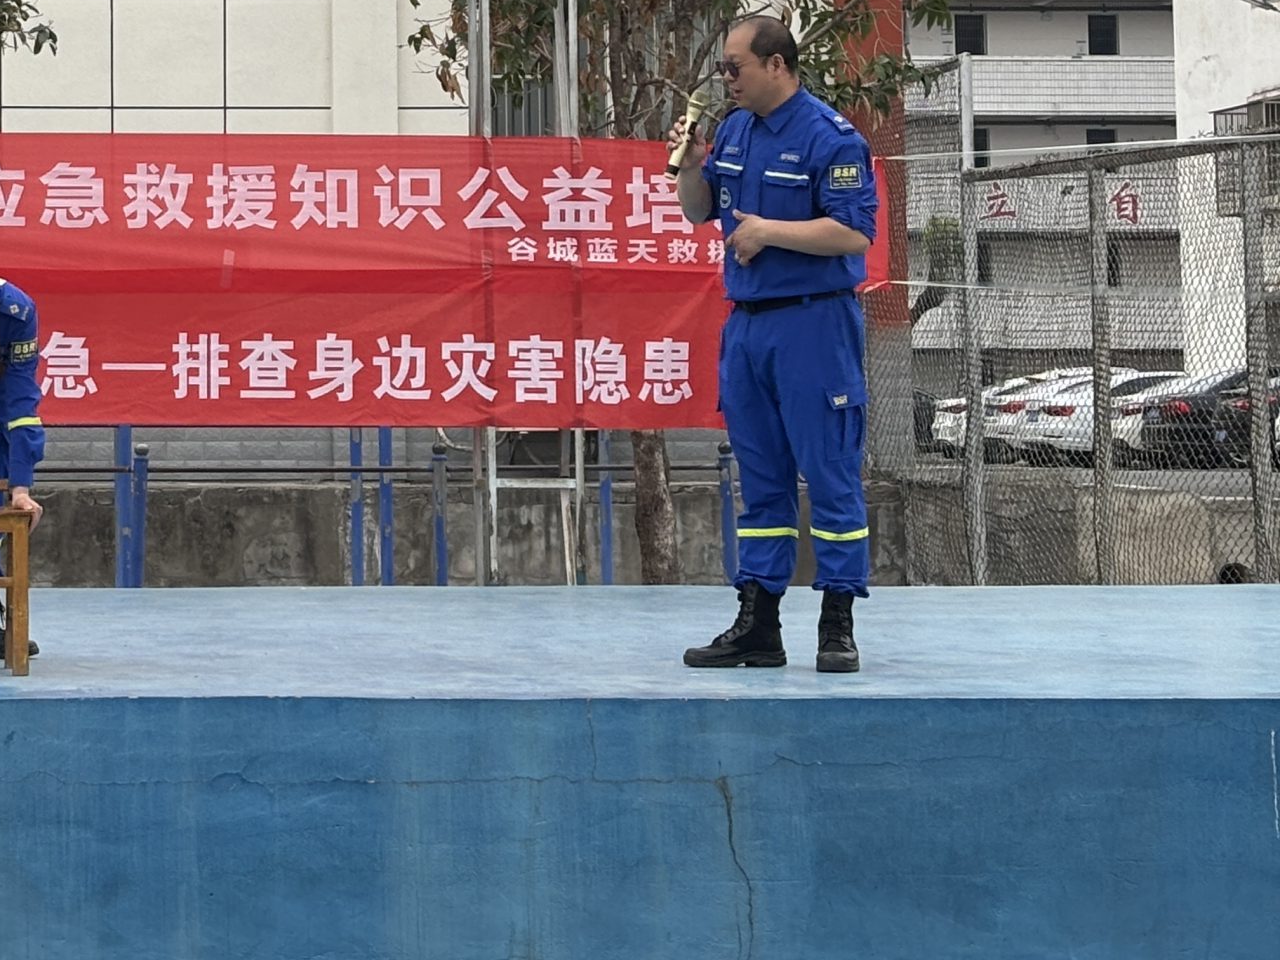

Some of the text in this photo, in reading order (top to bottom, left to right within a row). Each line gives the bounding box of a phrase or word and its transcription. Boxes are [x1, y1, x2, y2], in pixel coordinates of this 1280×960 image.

[833, 167, 857, 178] BSR
[979, 180, 1142, 224] 立 自
